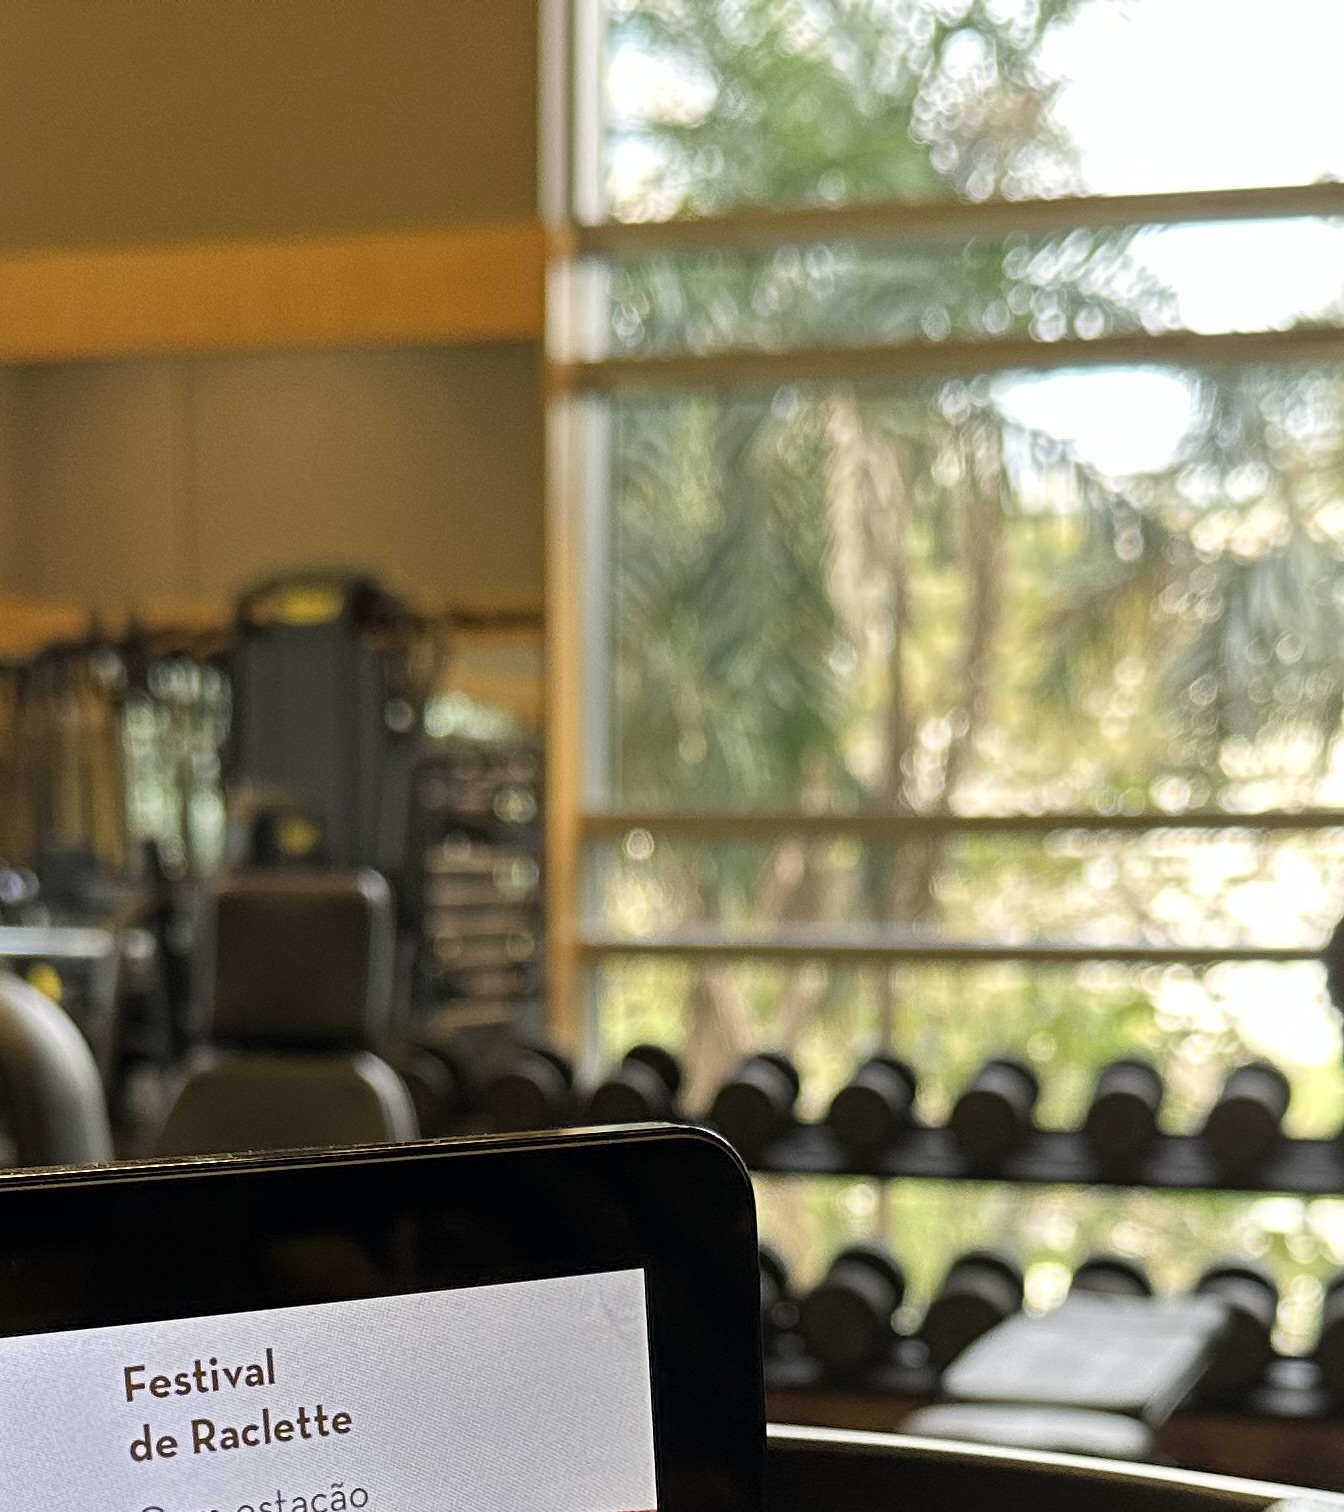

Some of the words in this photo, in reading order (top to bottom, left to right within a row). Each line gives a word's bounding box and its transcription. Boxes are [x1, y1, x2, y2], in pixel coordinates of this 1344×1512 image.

[123, 1347, 276, 1402] Festival
[129, 1424, 178, 1462] de
[191, 1404, 353, 1454] Raclette
